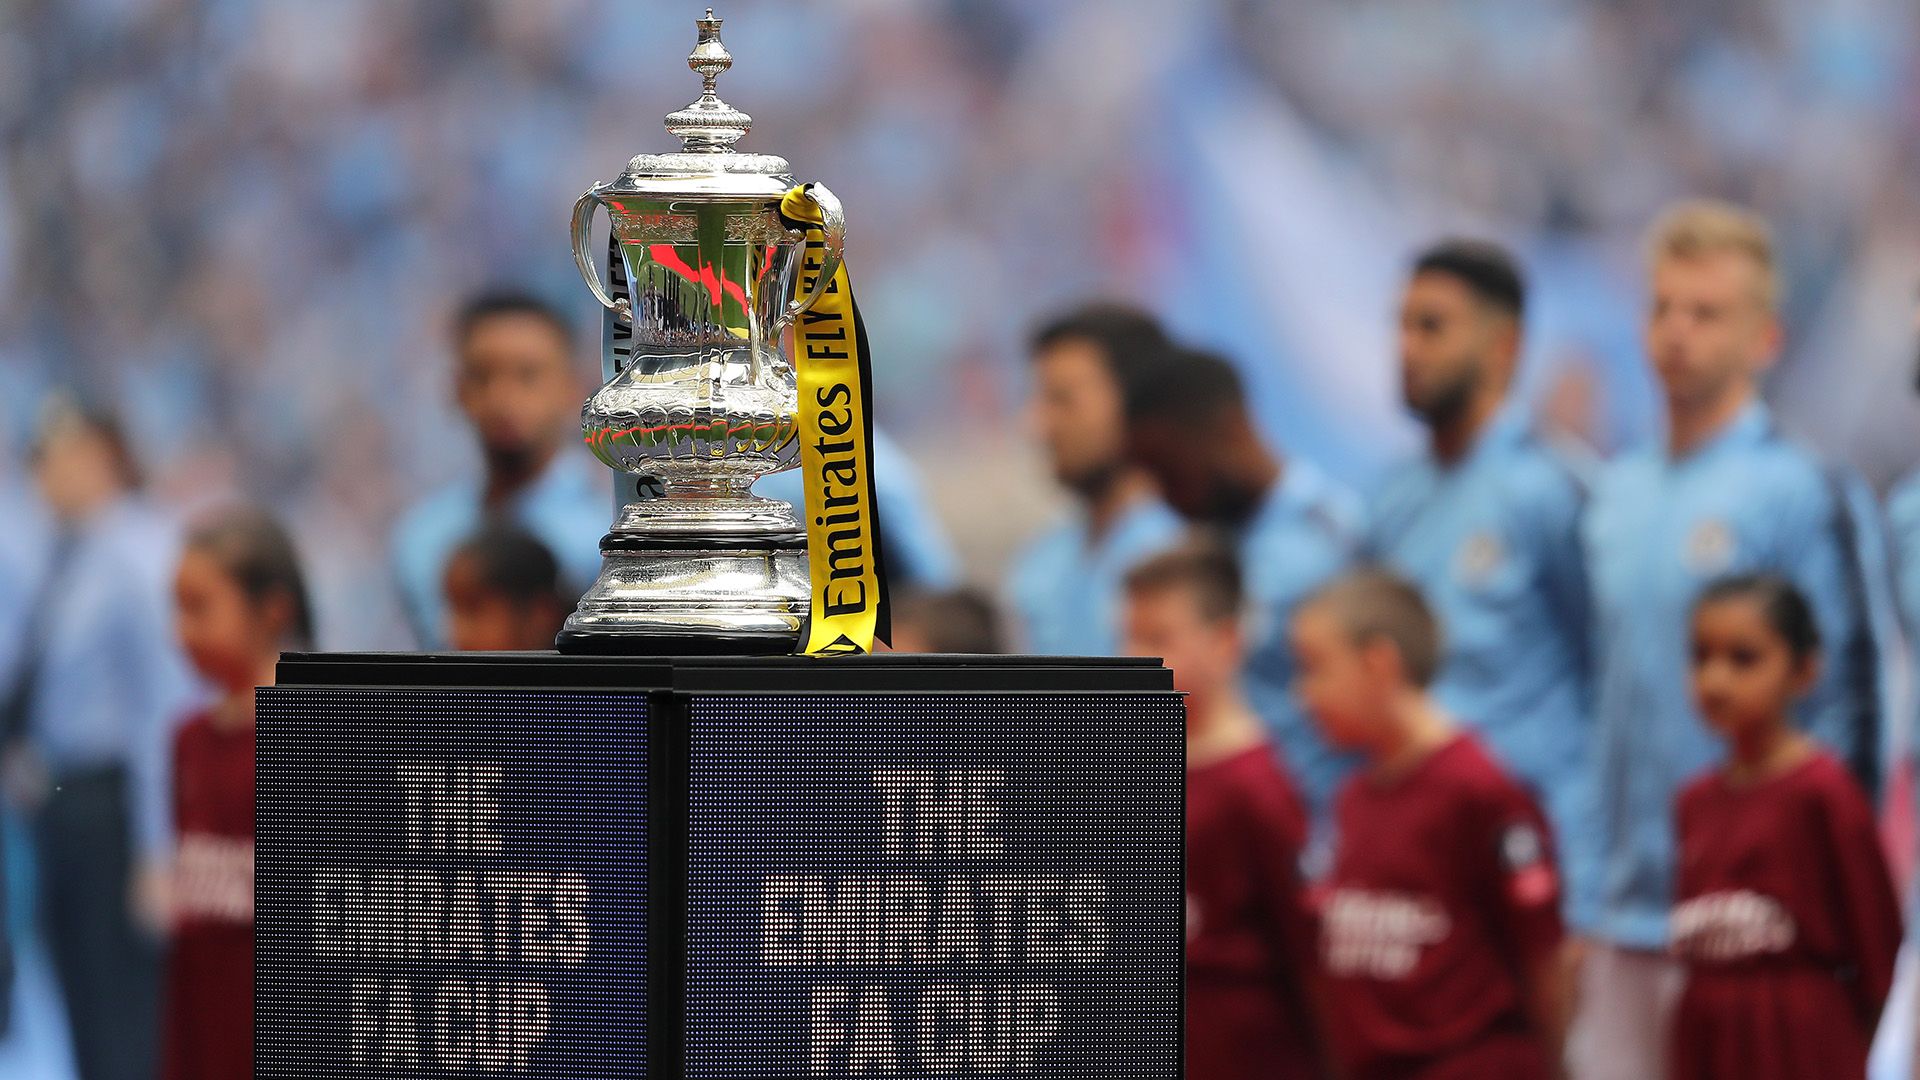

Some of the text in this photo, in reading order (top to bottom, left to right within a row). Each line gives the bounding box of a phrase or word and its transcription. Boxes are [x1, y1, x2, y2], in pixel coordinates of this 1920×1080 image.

[803, 310, 848, 359] FLY
[813, 383, 866, 619] Emirates
[397, 764, 502, 855] THE
[872, 769, 1004, 860] THE
[314, 867, 590, 968] EMIRATES
[762, 873, 1108, 966] EMIRATES
[351, 977, 551, 1072] FA CUP
[810, 983, 1059, 1077] FA CUP
